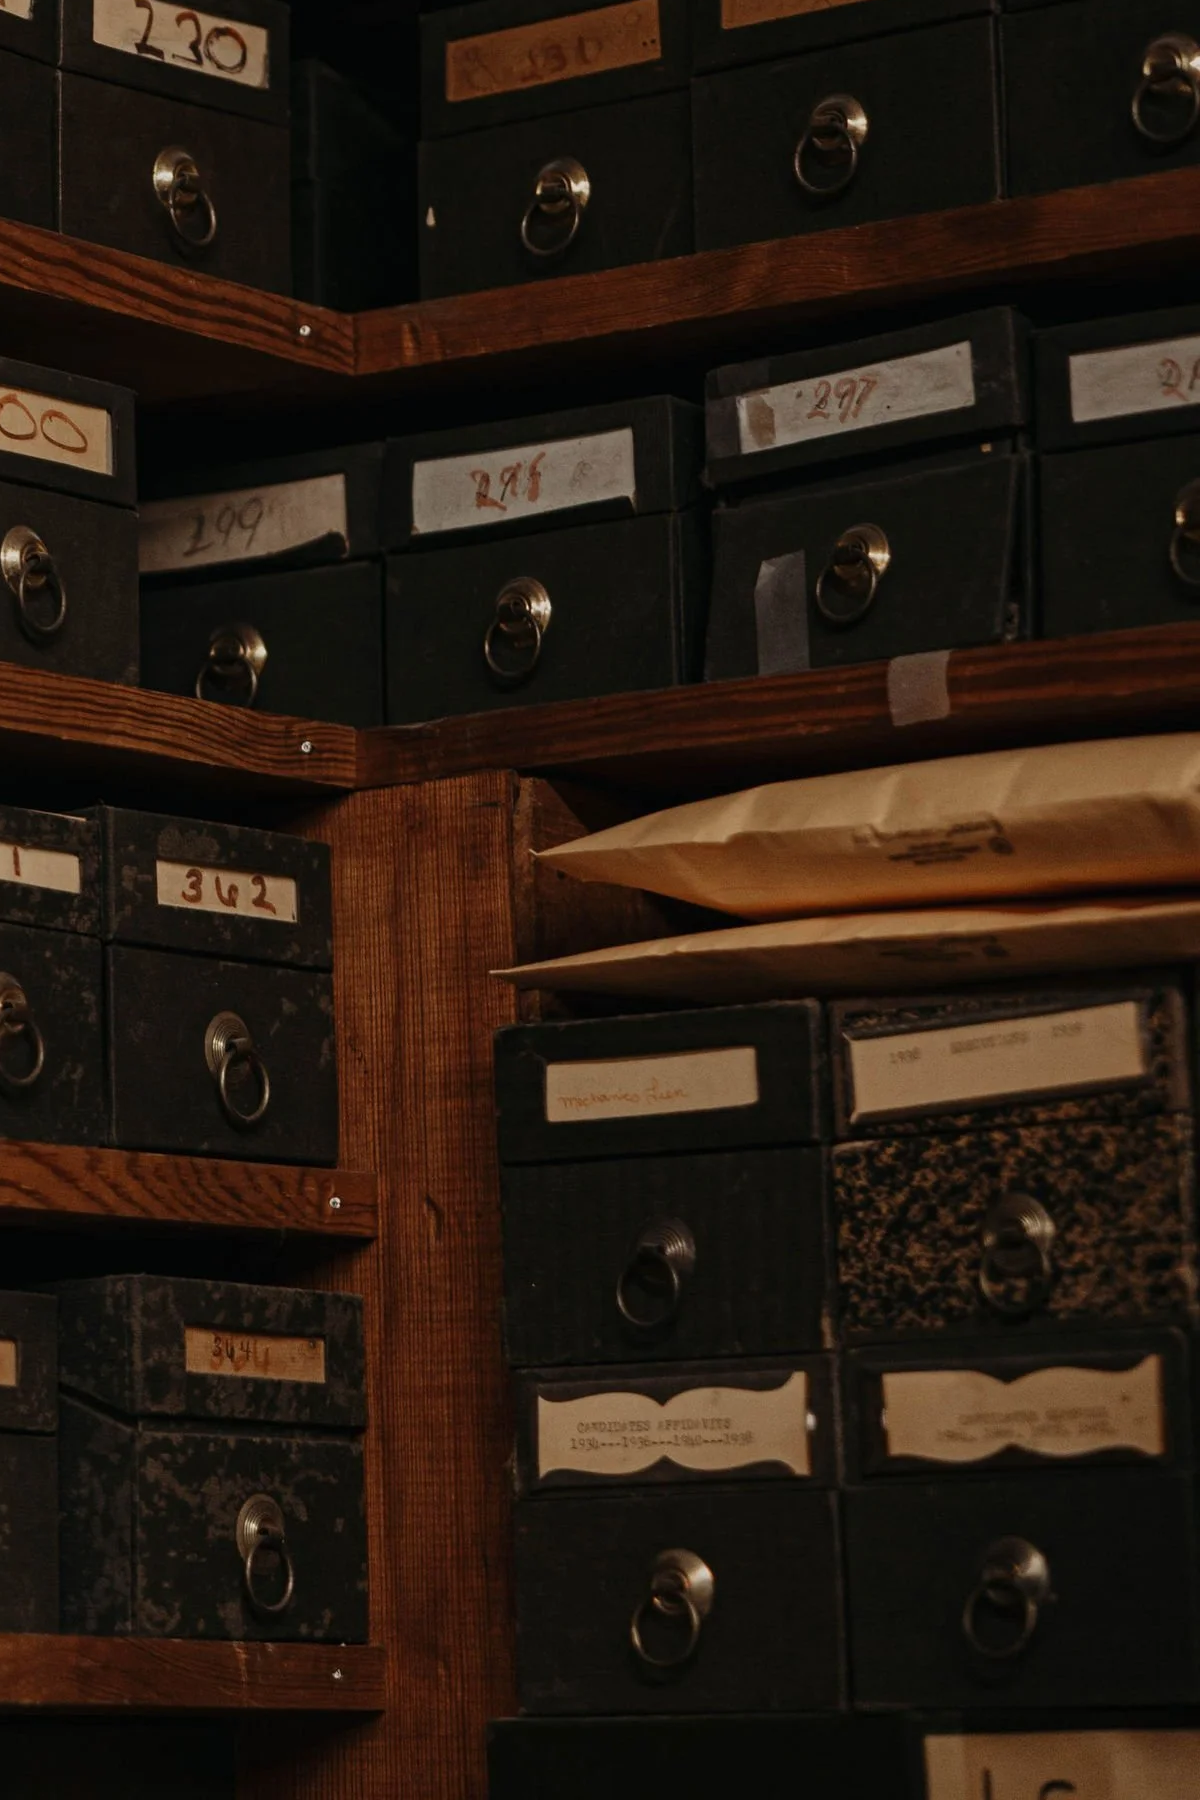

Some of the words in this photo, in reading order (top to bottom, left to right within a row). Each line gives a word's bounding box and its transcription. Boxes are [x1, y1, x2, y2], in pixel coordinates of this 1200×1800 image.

[135, 0, 247, 74] 230
[807, 375, 879, 422] 297
[182, 495, 264, 559] 299
[182, 868, 277, 915] 362
[576, 1420, 651, 1434] CANDIDATES
[657, 1418, 732, 1432] AFFIDAVITS
